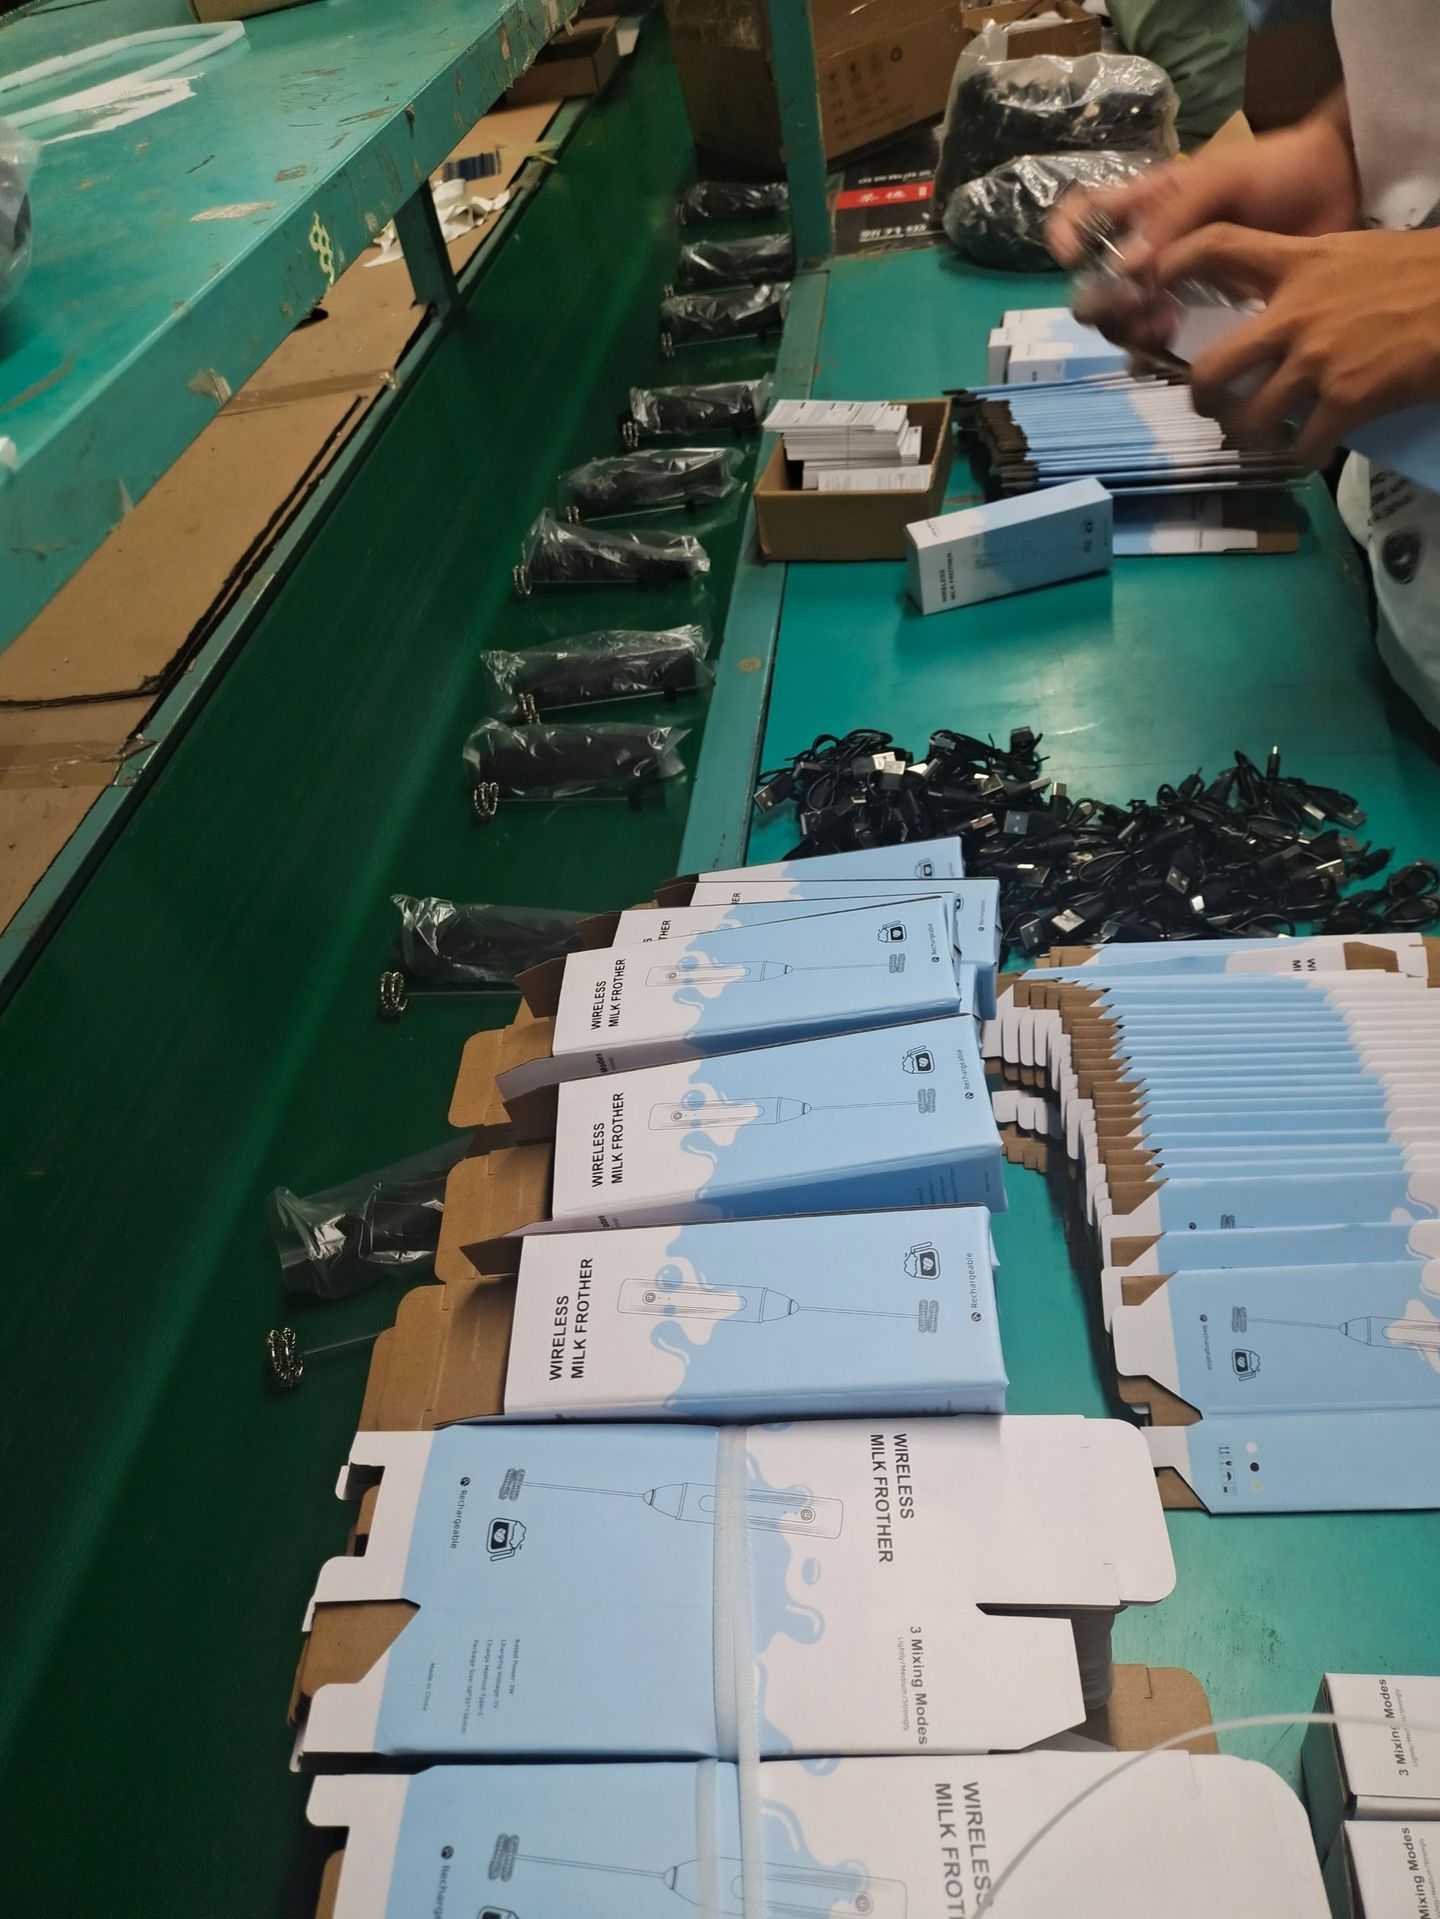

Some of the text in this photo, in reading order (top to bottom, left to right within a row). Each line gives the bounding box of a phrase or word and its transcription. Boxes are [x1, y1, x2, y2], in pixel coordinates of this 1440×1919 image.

[927, 923, 938, 956] Rechargeable
[590, 979, 608, 1032] WIRELESS
[607, 957, 627, 1028] MILK FROTHER
[957, 1048, 971, 1093] Rechargeable
[591, 1122, 605, 1187] WIRELESS
[610, 1092, 625, 1184] MILK FROTHER
[967, 1252, 979, 1310] Rechargeable
[548, 1294, 571, 1382] WIRELESS
[570, 1256, 594, 1381] MILK FROTHER
[869, 1433, 894, 1566] MILK FROTHER
[893, 1432, 916, 1521] WIRELESS
[450, 1489, 468, 1550] Rechargeable
[910, 1625, 929, 1745] 3 Mixing Modes
[1377, 1678, 1396, 1720] Modes
[1397, 1768, 1410, 1777] 3
[934, 1782, 966, 1919] MILK FROT
[1400, 1826, 1432, 1919] Mixing Modes
